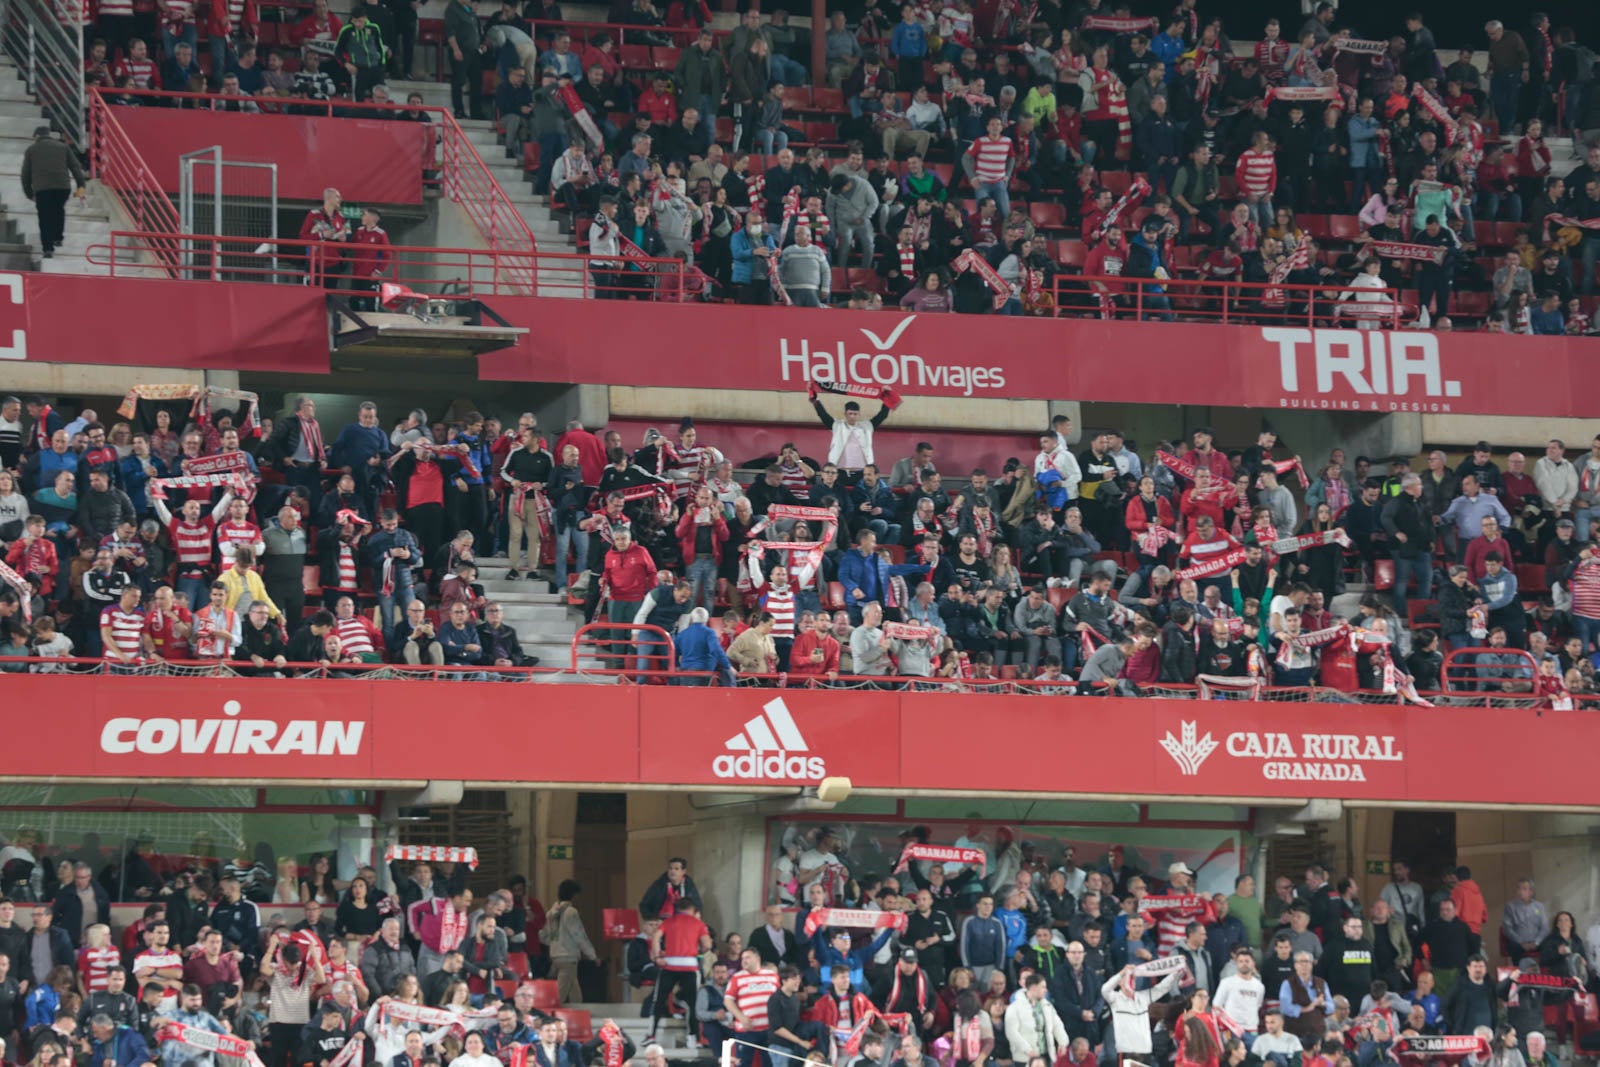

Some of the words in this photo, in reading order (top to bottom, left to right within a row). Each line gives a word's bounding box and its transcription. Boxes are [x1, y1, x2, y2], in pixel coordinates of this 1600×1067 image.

[1279, 398, 1360, 409] BUILDING
[1371, 401, 1380, 410] &
[1390, 401, 1451, 412] DESIGN
[1181, 558, 1226, 580] GRANADA
[1227, 552, 1241, 565] CF
[1226, 732, 1297, 759] CAJA
[1302, 733, 1403, 761] RURAL
[712, 748, 826, 780] adidas
[1262, 762, 1367, 782] GRANADA
[913, 846, 960, 860] GRANADA
[962, 849, 976, 860] CF
